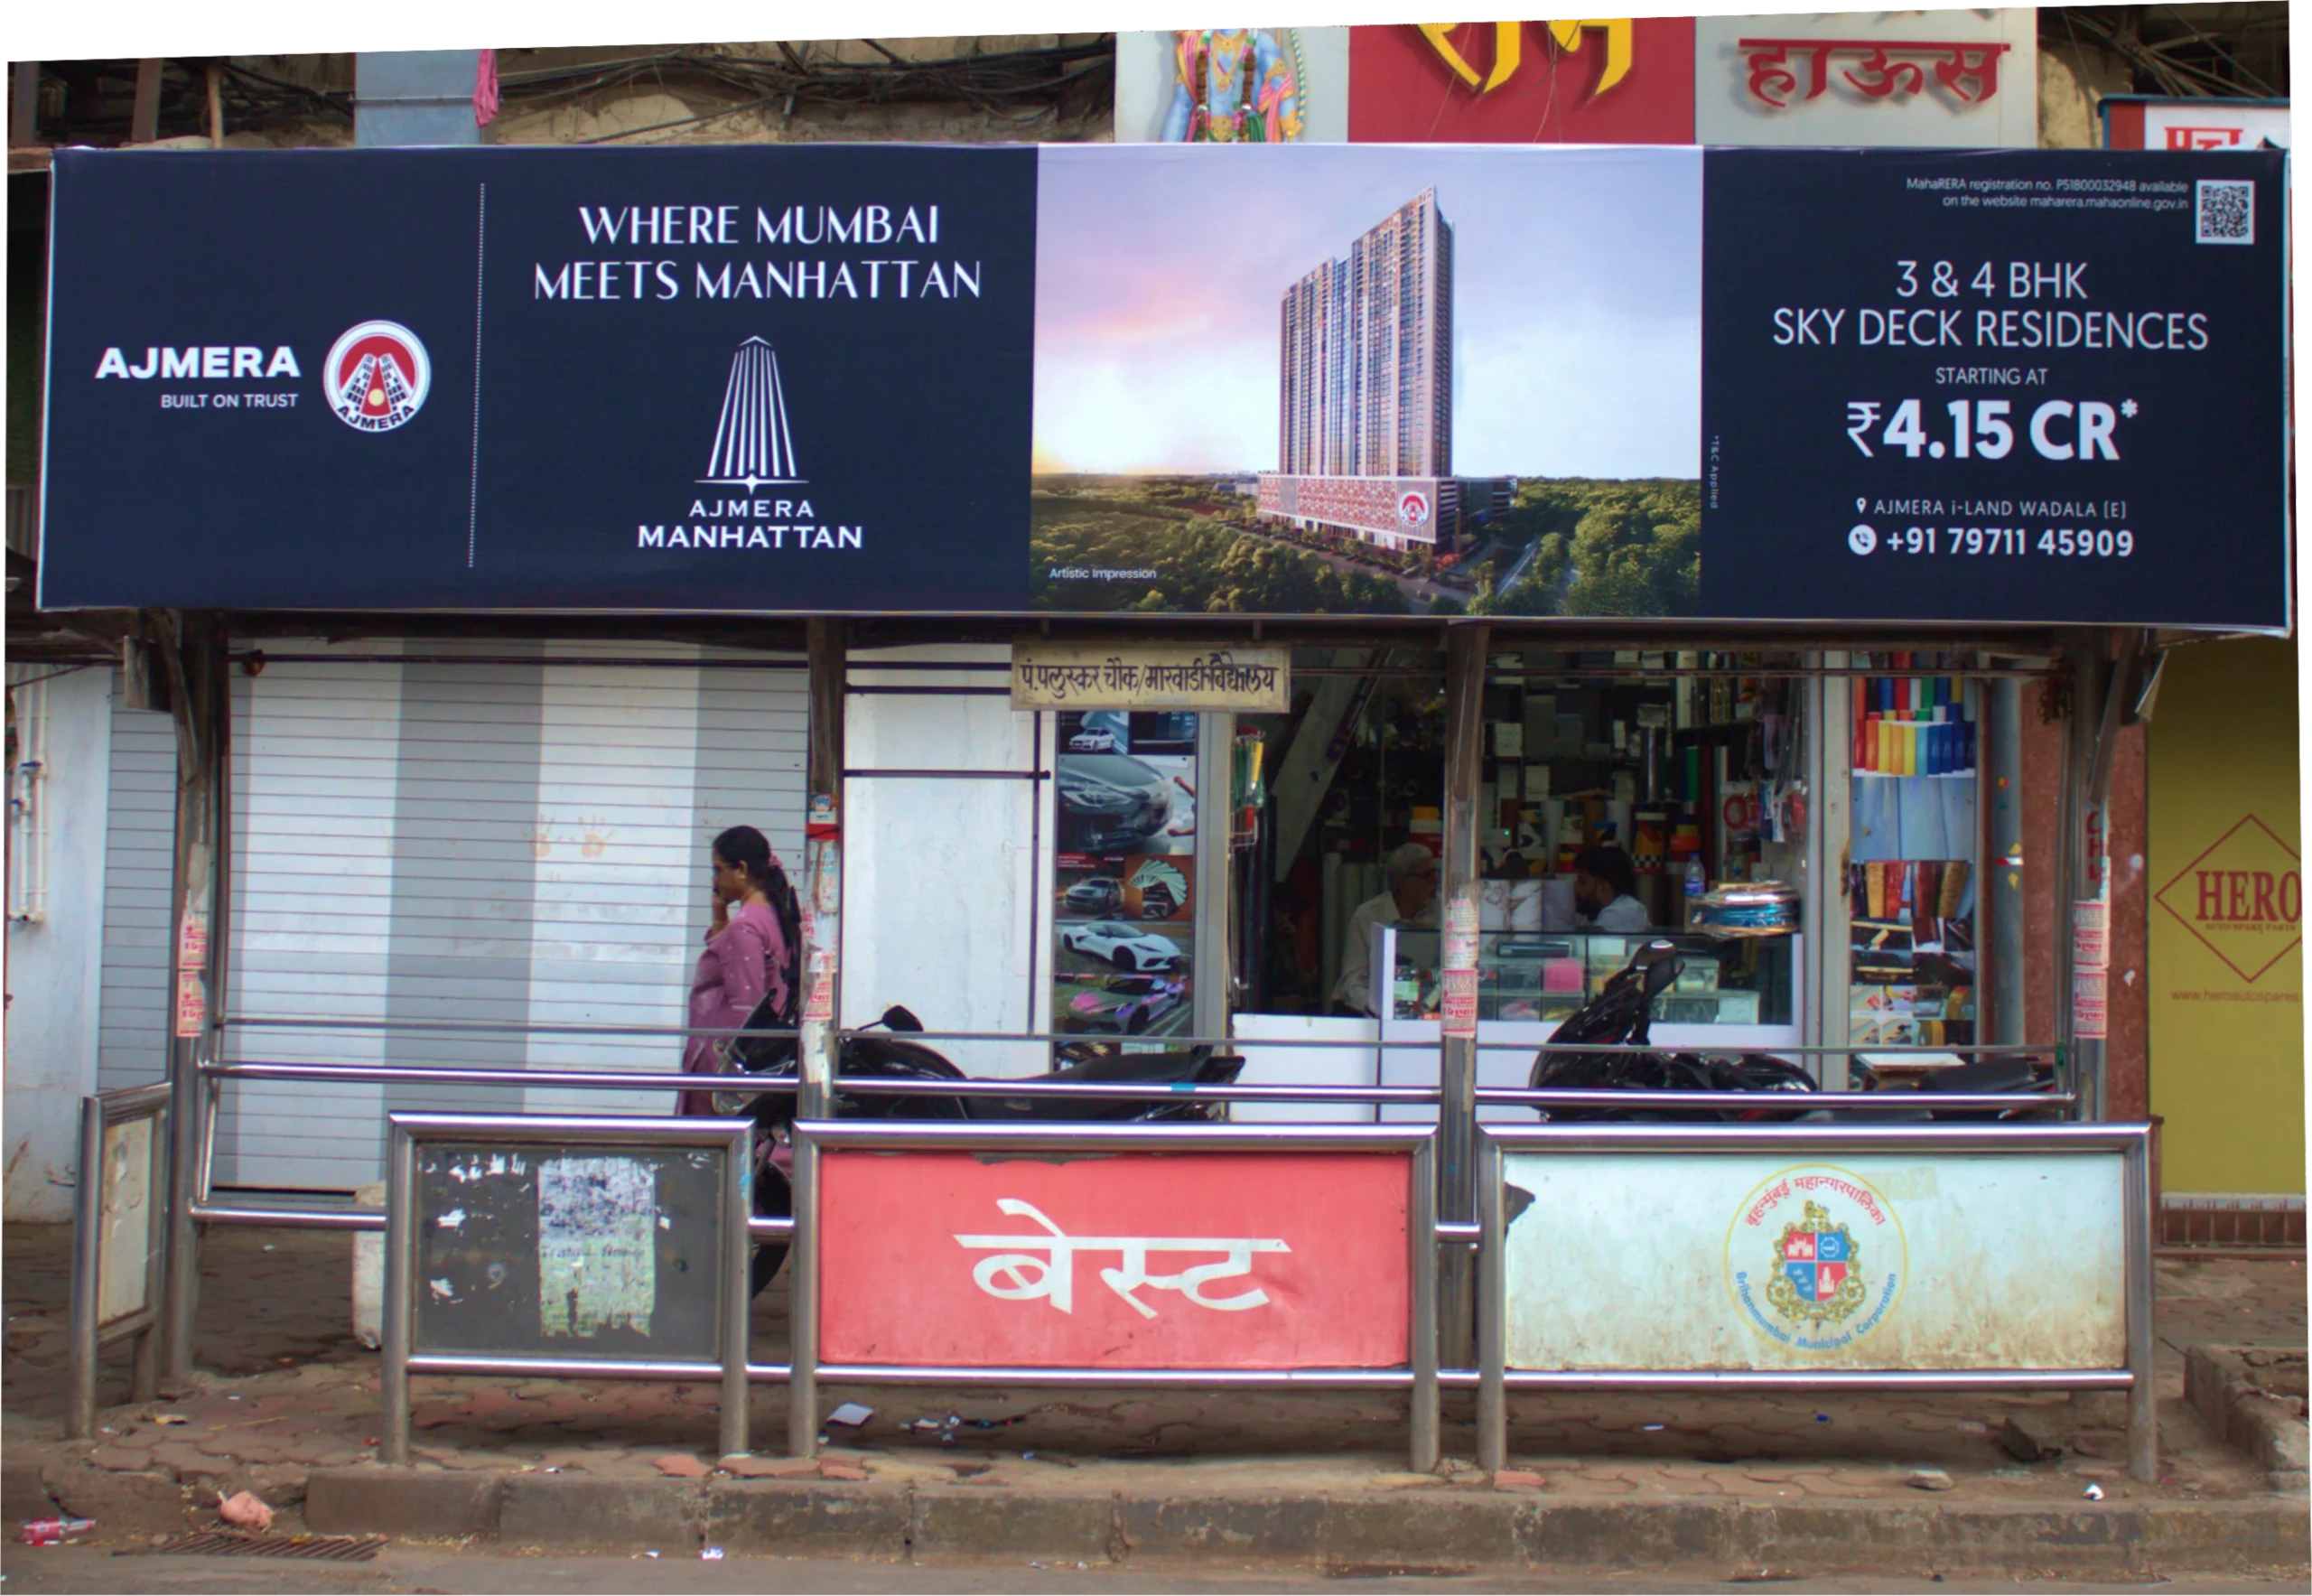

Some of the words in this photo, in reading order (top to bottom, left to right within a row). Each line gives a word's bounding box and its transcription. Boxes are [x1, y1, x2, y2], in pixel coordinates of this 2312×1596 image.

[1738, 38, 2011, 107] हाऊस
[1906, 178, 1966, 190] MahaRERA
[1970, 178, 2033, 192] registration
[2036, 181, 2054, 191] no.
[2139, 181, 2189, 193] available
[1943, 197, 1958, 207] on
[1961, 195, 1980, 207] the
[1982, 195, 2028, 208] website
[2030, 195, 2189, 211] maharera.mahaonline.gov.in
[579, 205, 740, 245] WHERE
[757, 205, 939, 245] MUMBAI
[535, 260, 679, 300] MEETS
[696, 259, 981, 300] MANHATTAN
[1896, 260, 1918, 298] 3
[1931, 260, 1959, 298] &
[1970, 261, 1996, 298] 4
[2009, 261, 2089, 299] BHK
[1773, 307, 1846, 346] SKY
[1859, 308, 1962, 347] DECK
[1976, 310, 2209, 350] RESIDENCES
[95, 345, 302, 380] AJMERA
[1935, 368, 2021, 386] STARTING
[2026, 368, 2048, 385] AT
[161, 392, 206, 408] BUILT
[212, 392, 238, 408] ON
[244, 392, 300, 408] TRUST
[336, 405, 415, 430] AJMERA
[1847, 399, 2014, 460] ₹4.15
[1709, 465, 1720, 509] Applied
[688, 499, 815, 518] AJMERA
[1874, 499, 1944, 515] AJMERA
[1952, 499, 2013, 517] i-LAND
[2019, 500, 2097, 518] WADALA
[638, 524, 863, 549] MANHATTAN
[1886, 527, 1935, 555] +91
[1947, 527, 2026, 555] 79711
[2037, 528, 2134, 556] 45909
[1049, 567, 1089, 579] Artistic
[1092, 567, 1157, 582] Impression
[2195, 871, 2303, 922] HERO
[2266, 924, 2297, 932] PARTS
[953, 1198, 1292, 1320] बेस्ट
[1736, 1271, 1792, 1344] Brihanmumbai
[1795, 1330, 1851, 1350] Municipal
[1856, 1272, 1897, 1335] Corporation
